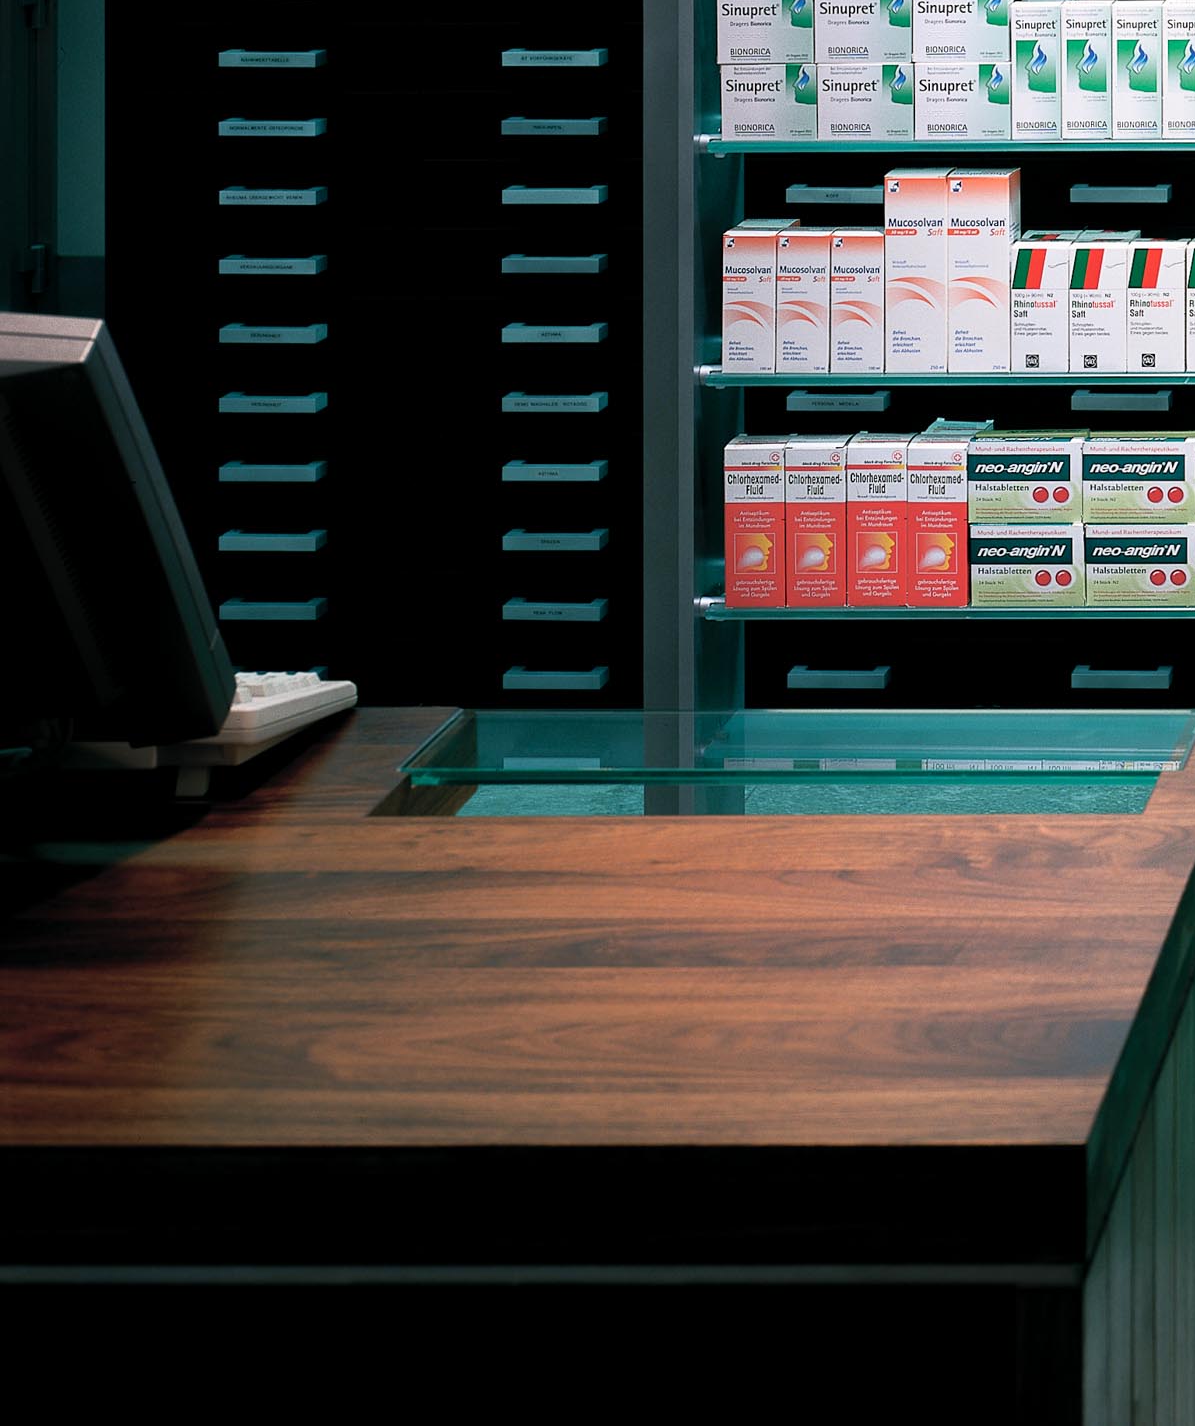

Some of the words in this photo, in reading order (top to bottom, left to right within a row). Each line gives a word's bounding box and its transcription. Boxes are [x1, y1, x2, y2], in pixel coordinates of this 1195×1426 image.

[722, 4, 776, 18] Sinupret
[820, 3, 874, 17] Sinupret
[918, 1, 972, 16] Sinupret
[1016, 20, 1055, 31] Sinupret
[1066, 19, 1106, 30] Sinupret
[822, 79, 876, 94] Sinupret
[888, 218, 943, 227] Mucosolvan
[1014, 300, 1056, 308] Rhinotussal
[1130, 300, 1172, 308] Rhinotussal
[1014, 310, 1028, 318] Saft
[728, 475, 782, 485] Chlorhexamed-
[850, 473, 904, 483] Chlorhexamed-
[910, 475, 964, 485] Chlorhexamed-
[746, 485, 763, 495] Fluid
[869, 484, 886, 494] Fluid
[929, 485, 945, 495] Fluid
[1093, 567, 1146, 575] Halstabletten
